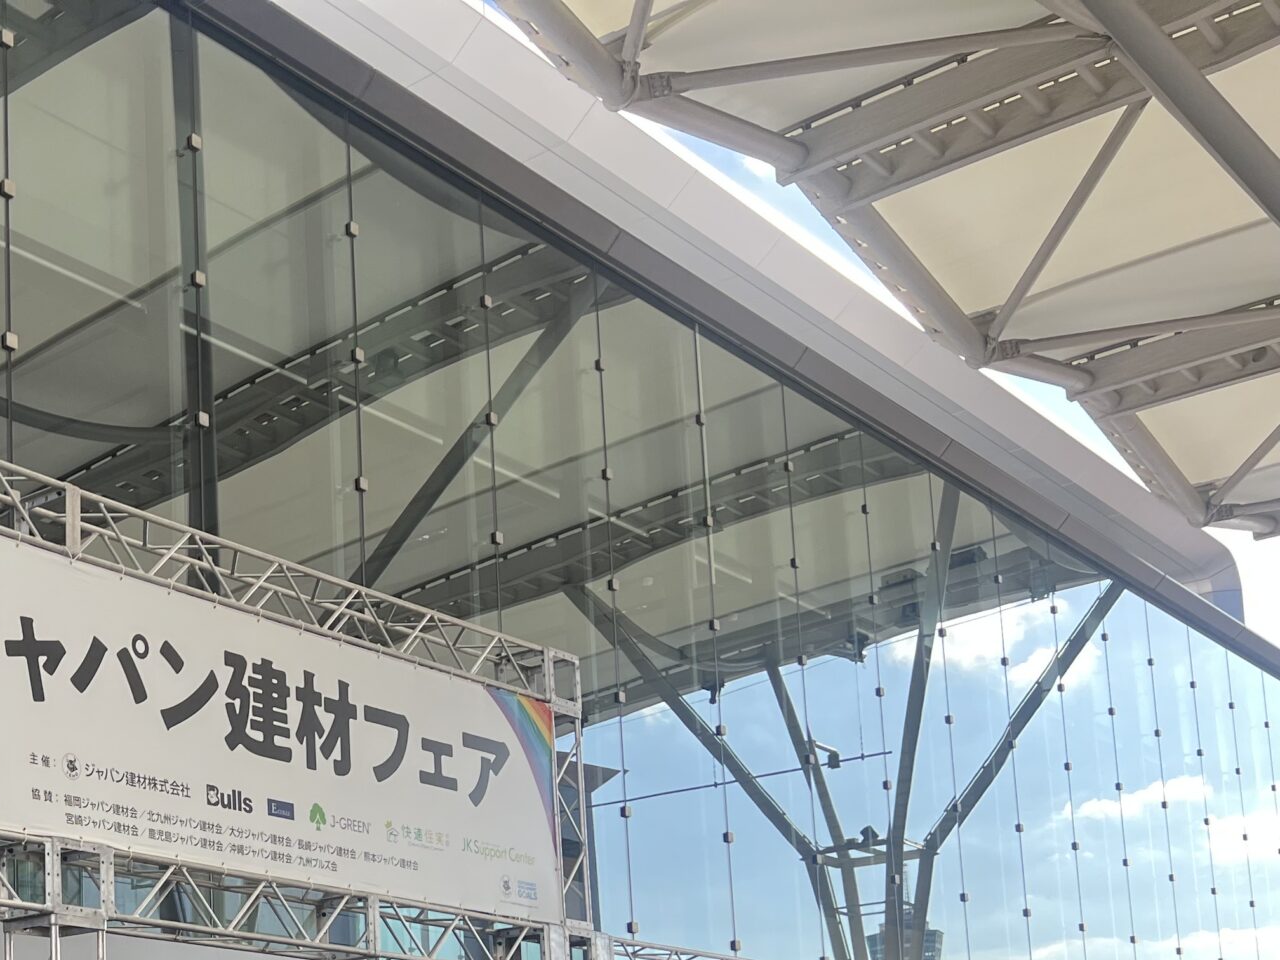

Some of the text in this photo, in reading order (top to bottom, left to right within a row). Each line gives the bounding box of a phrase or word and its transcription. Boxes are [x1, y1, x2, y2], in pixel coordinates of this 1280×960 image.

[84, 763, 191, 798] ジャパン建材株式会社
[206, 784, 253, 813] Bulls
